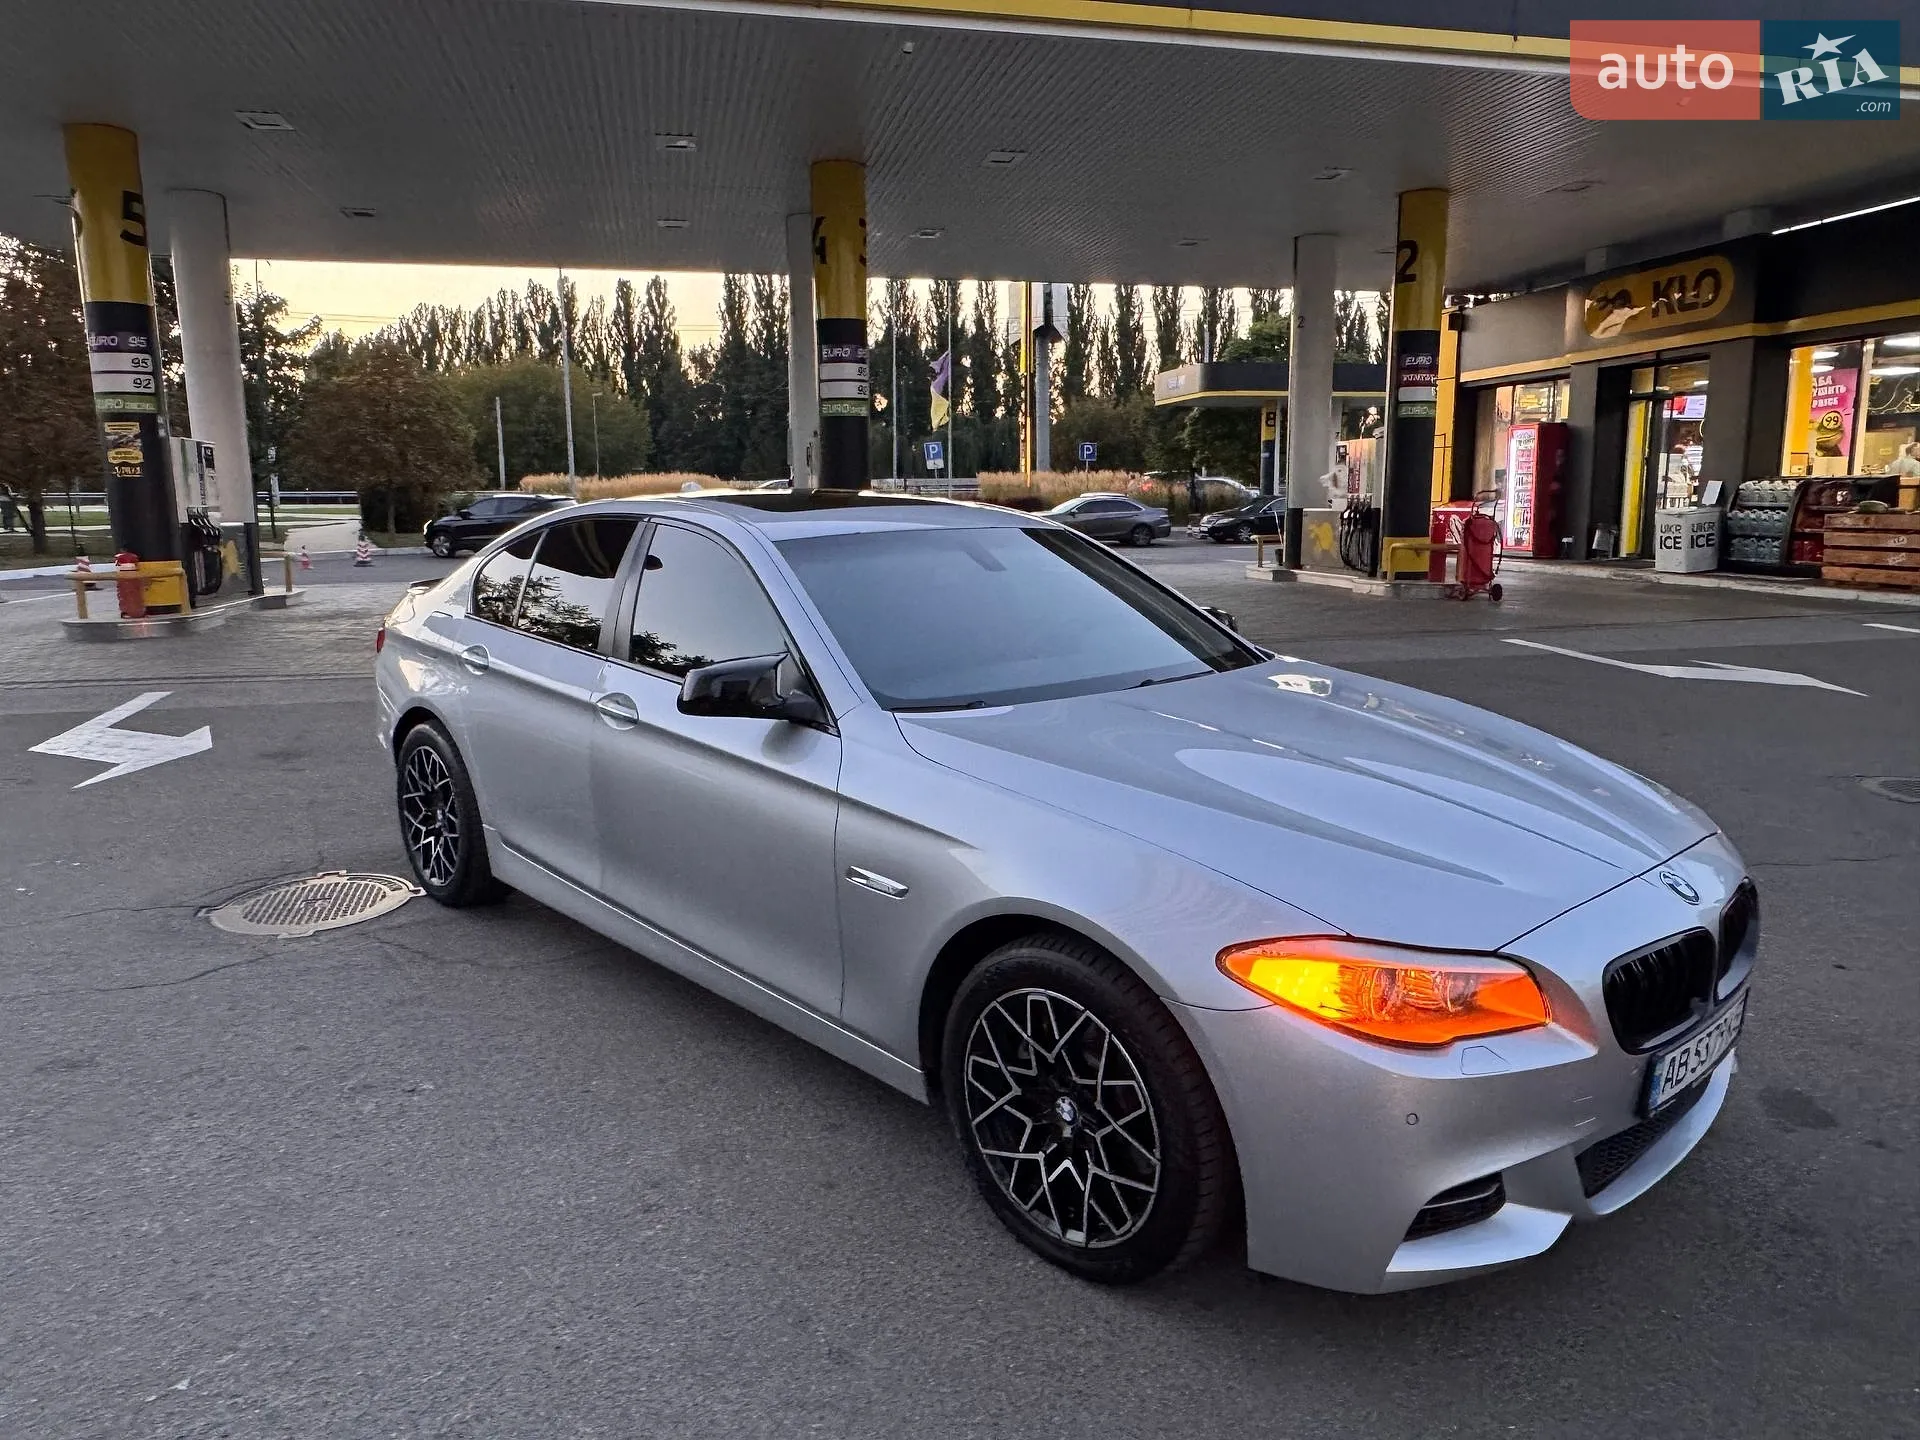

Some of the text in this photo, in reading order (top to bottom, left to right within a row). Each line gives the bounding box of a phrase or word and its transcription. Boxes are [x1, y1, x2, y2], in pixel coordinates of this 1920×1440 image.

[120, 190, 148, 247] 5
[1397, 240, 1418, 284] 2
[1651, 268, 1722, 318] KLO
[128, 335, 148, 348] 95
[822, 347, 851, 358] EURO
[131, 357, 151, 369] 95
[1405, 355, 1433, 366] EURO
[133, 377, 153, 389] 92
[822, 403, 849, 414] EURO
[1824, 415, 1840, 427] 99
[930, 444, 938, 459] P
[1083, 446, 1093, 459] P
[1660, 535, 1682, 550] ICE
[1690, 533, 1715, 549] ICE
[1662, 1047, 1690, 1093] AB
